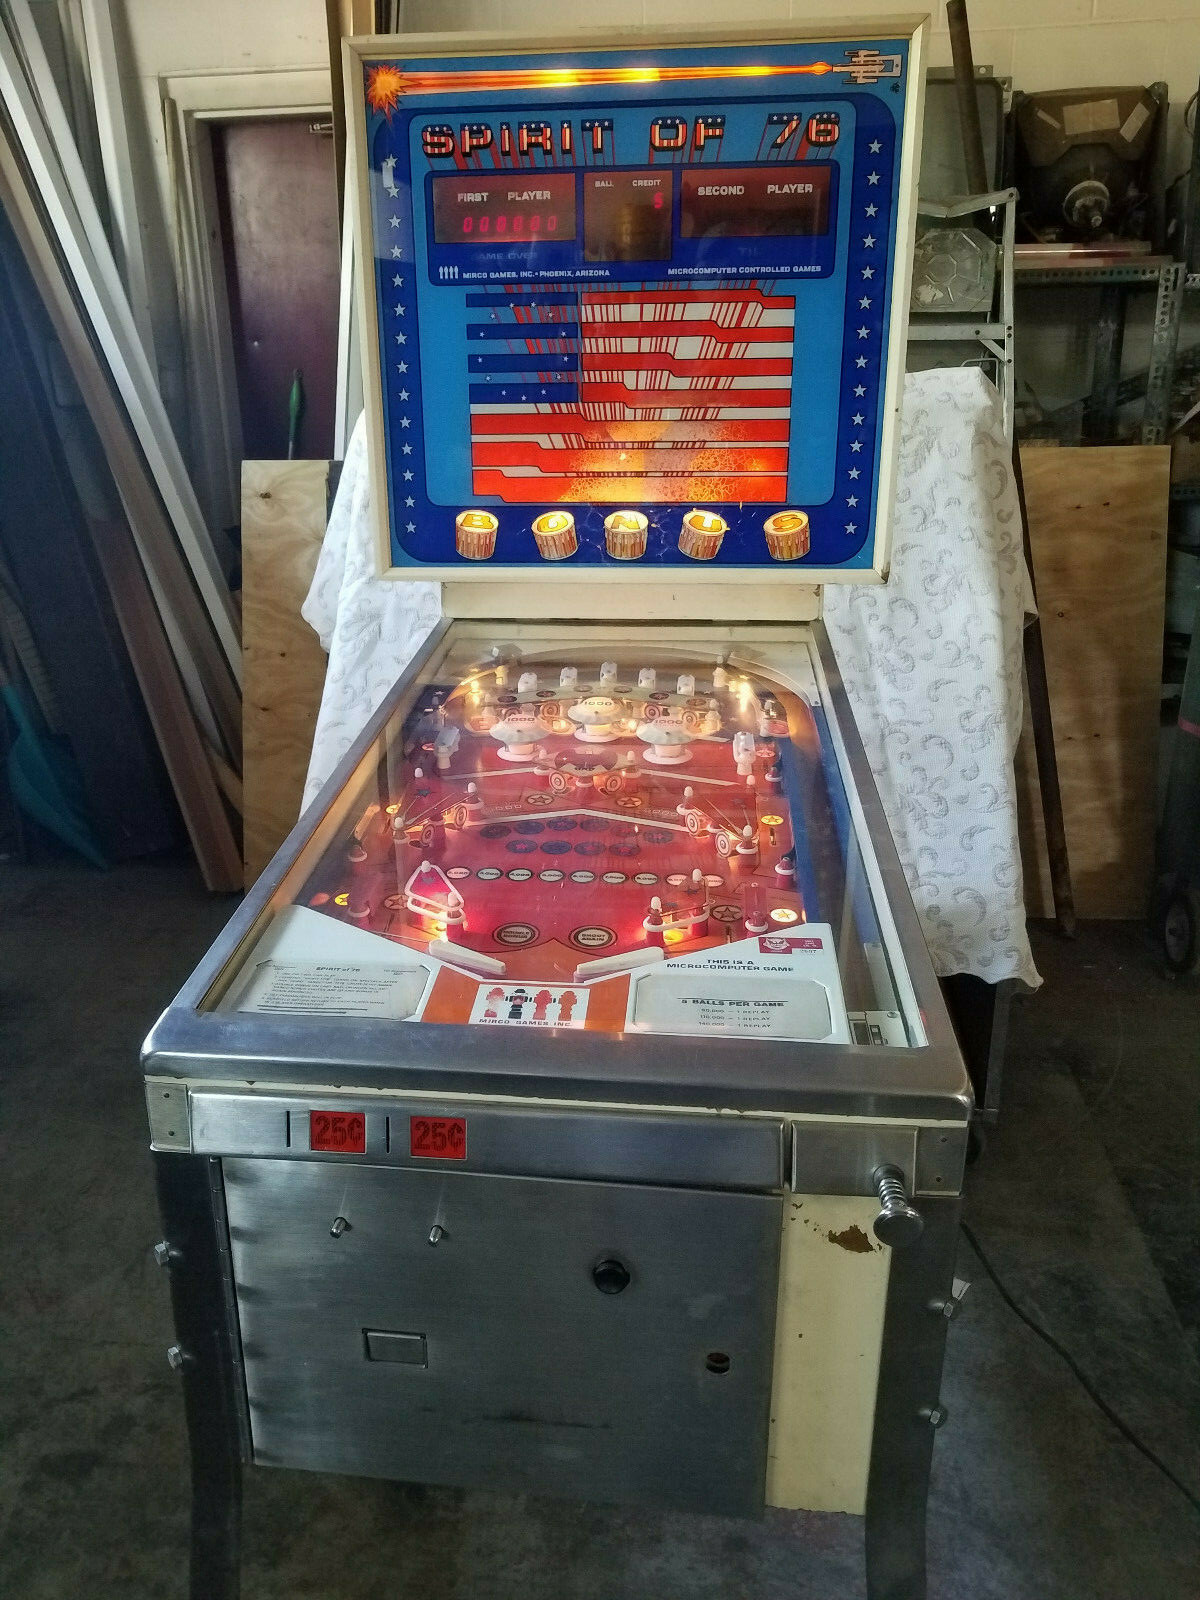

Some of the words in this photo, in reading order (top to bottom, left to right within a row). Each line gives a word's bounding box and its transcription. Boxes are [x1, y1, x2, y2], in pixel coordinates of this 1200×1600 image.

[422, 119, 613, 158] SPIRIT
[650, 114, 726, 152] OF
[767, 111, 840, 149] 76
[594, 180, 614, 188] BALL
[632, 179, 662, 187] CREDIT
[697, 184, 745, 196] SECOND
[767, 183, 814, 194] PLAYER
[457, 192, 489, 203] FIRST
[507, 190, 551, 201] PLAYER
[539, 270, 574, 278] PHOENIX,
[575, 269, 611, 277] ARIZONA
[667, 266, 737, 275] MICROCOMPUTER
[460, 513, 494, 529] B
[666, 963, 760, 971] MICROCOMPUTER
